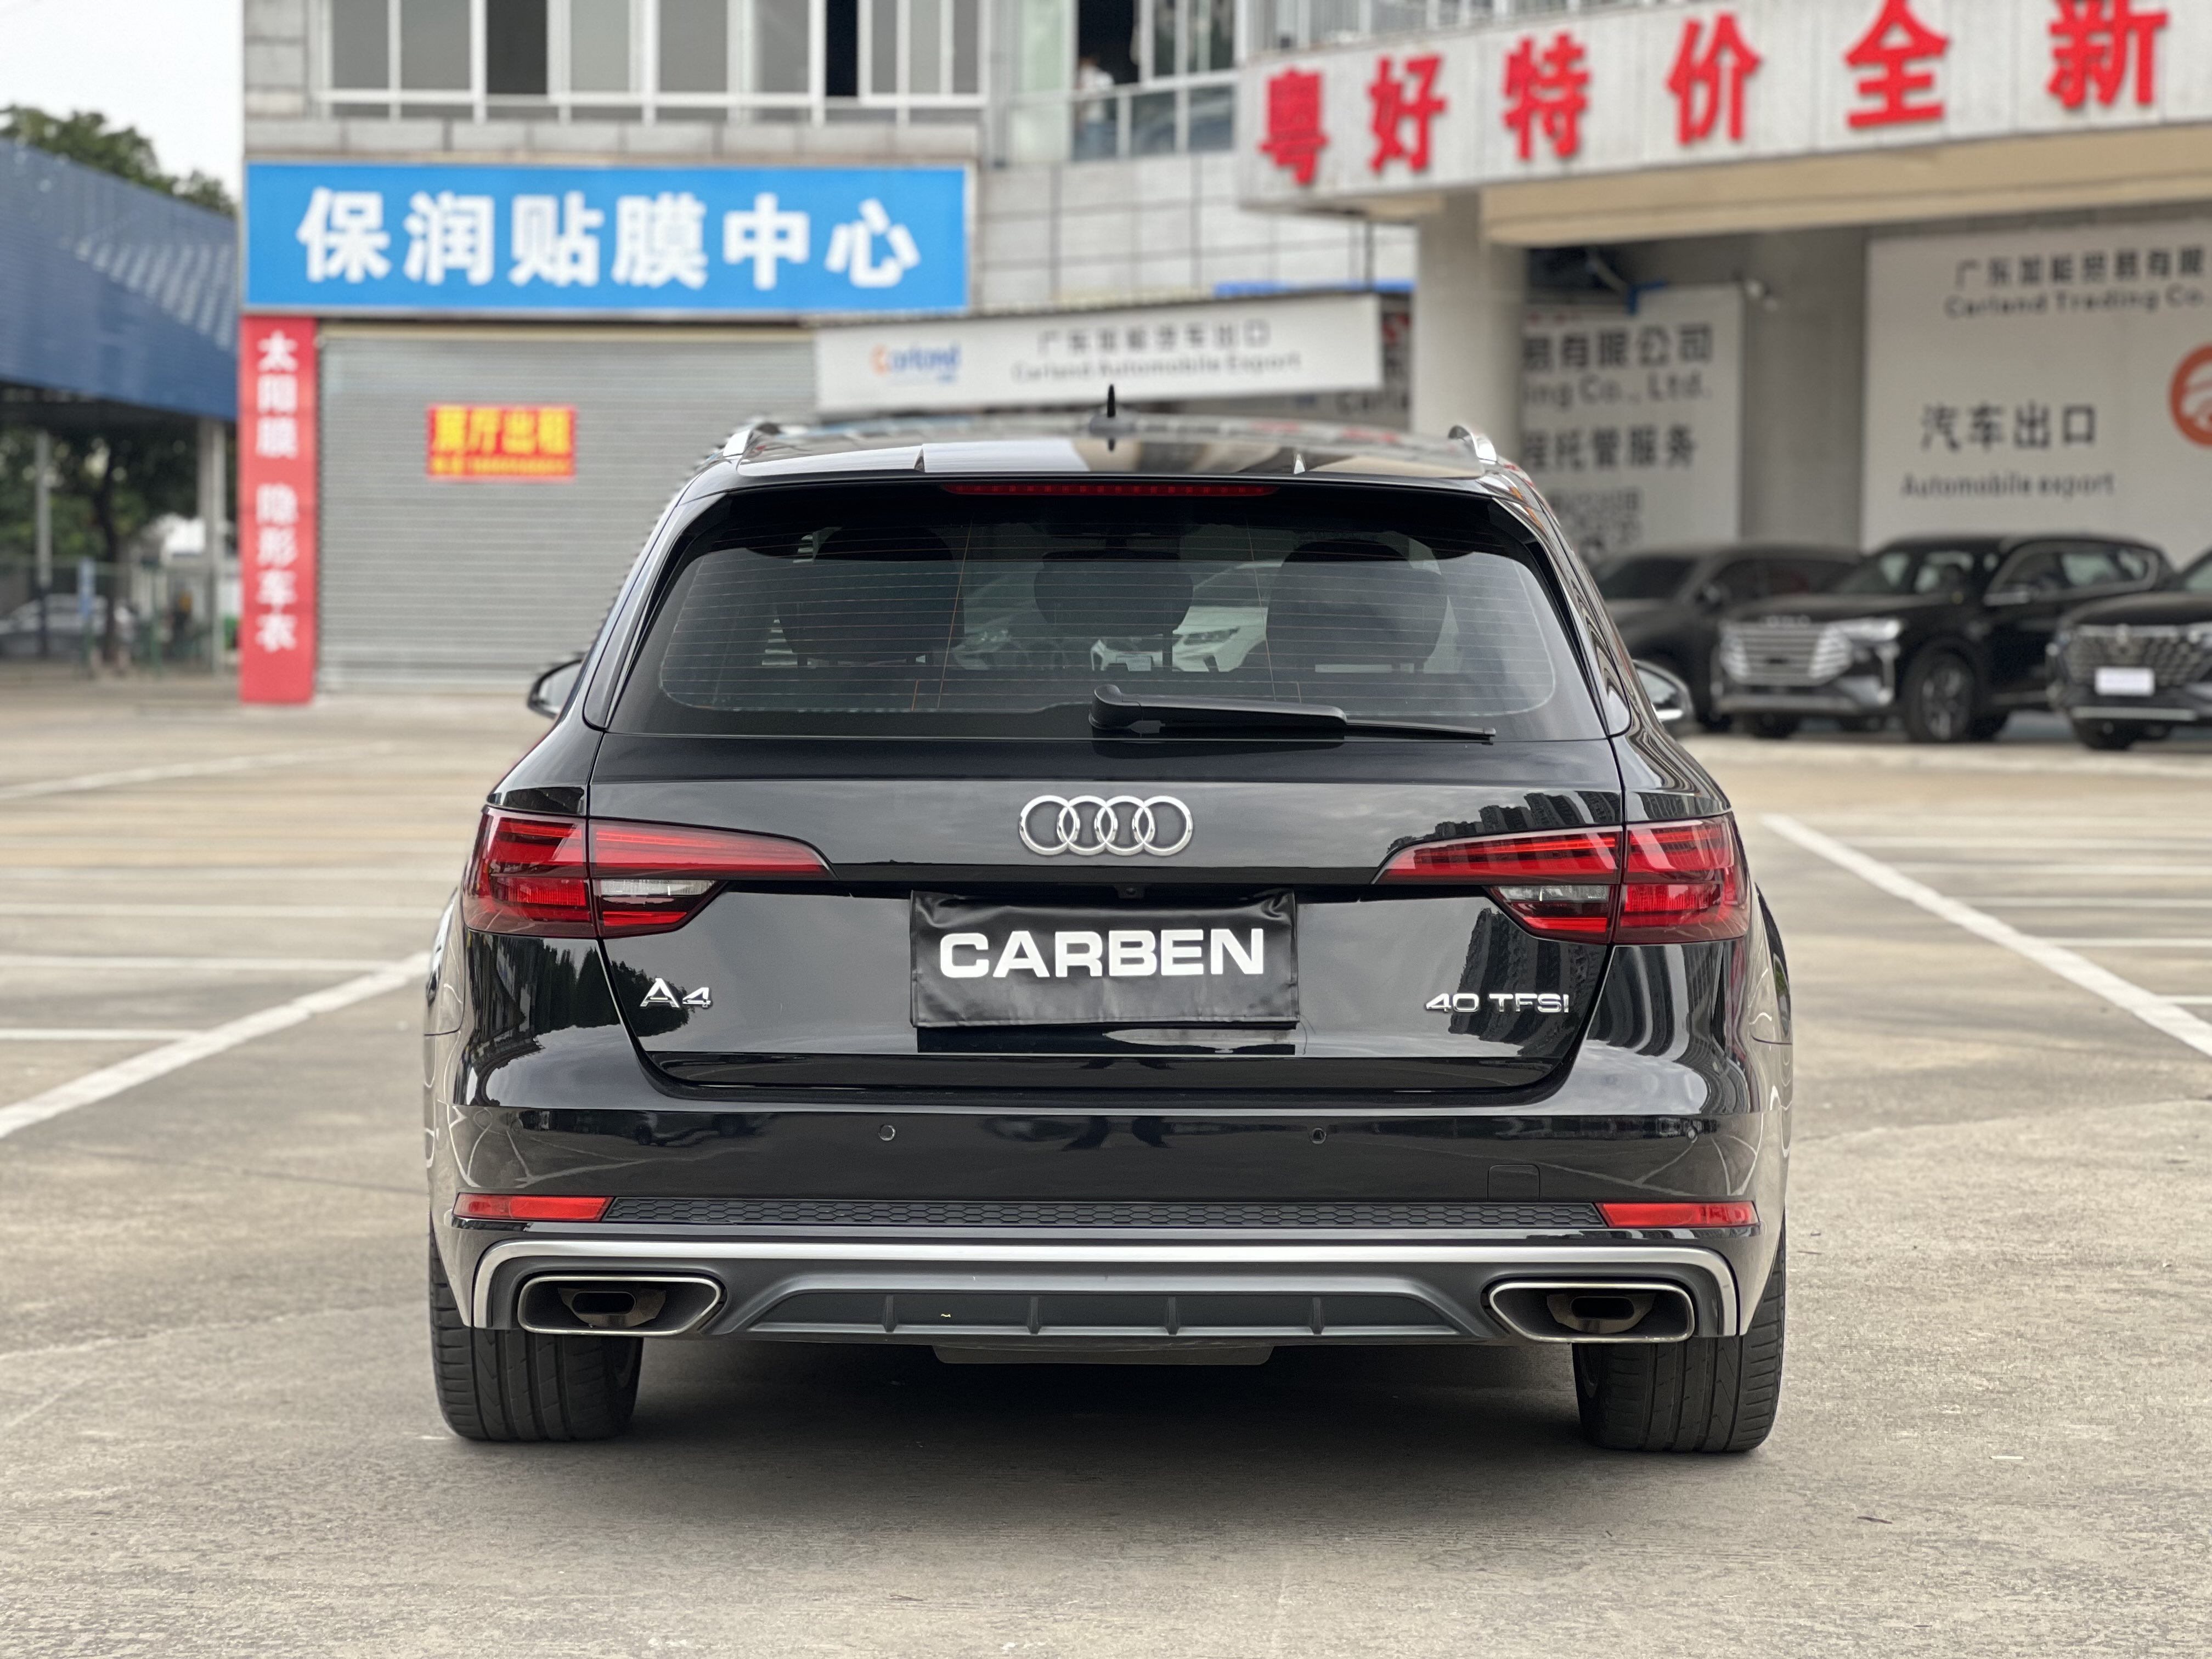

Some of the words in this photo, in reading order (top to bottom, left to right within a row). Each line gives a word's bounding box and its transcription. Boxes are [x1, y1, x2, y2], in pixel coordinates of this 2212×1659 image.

[297, 187, 921, 290] 保润贴膜中心
[1920, 401, 2097, 453] 汽车出口
[1901, 471, 2031, 498] Automobile
[2038, 472, 2114, 500] export
[940, 928, 1263, 978] CARBEN
[640, 978, 712, 1008] A4
[1426, 993, 1480, 1013] 40
[1488, 993, 1569, 1013] TFSI
